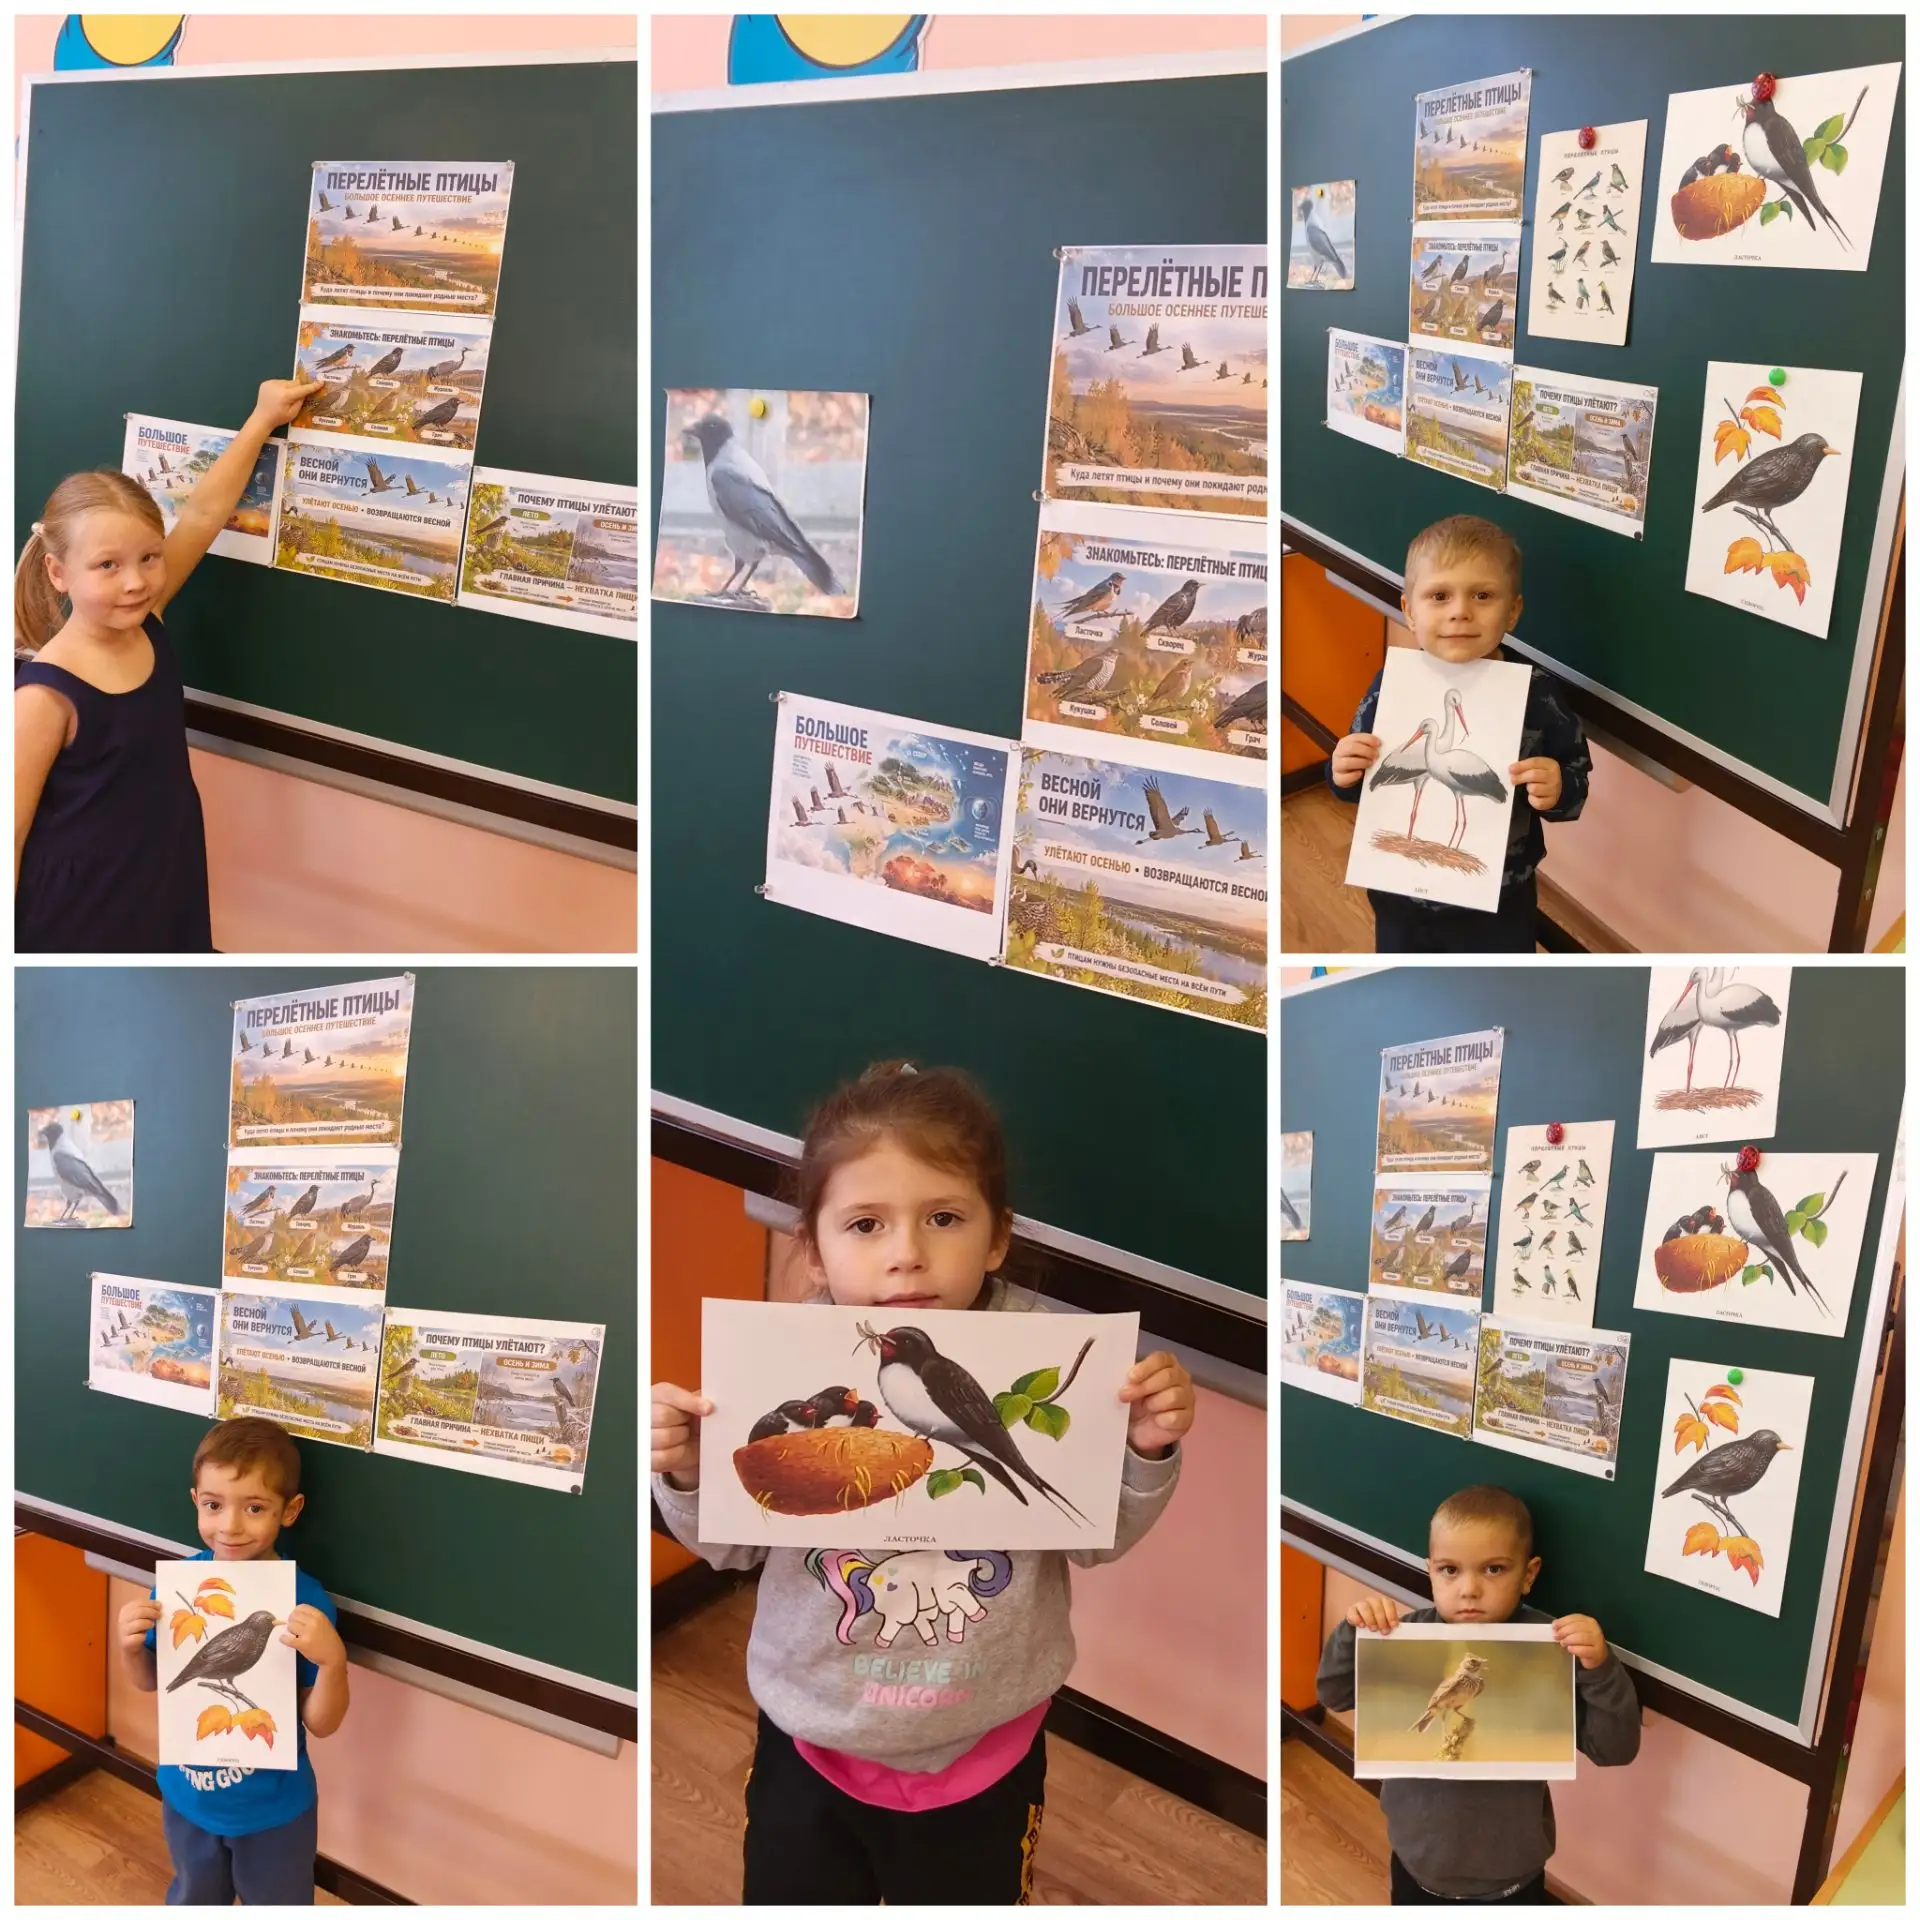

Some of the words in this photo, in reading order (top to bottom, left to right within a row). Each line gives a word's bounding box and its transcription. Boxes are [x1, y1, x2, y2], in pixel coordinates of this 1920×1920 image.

[1424, 90, 1482, 118] ПЕРЕЛЁТНЫЕ
[1484, 82, 1522, 107] ПТИЦЫ
[327, 168, 431, 191] ПЕРЕЛЁТНЫЕ
[436, 173, 498, 195] ПТИЦЫ
[344, 192, 378, 201] БОЛЬШОЕ
[381, 194, 414, 202] ОСЕННЕЕ
[417, 194, 472, 204] ПУТЕШЕСТВИЕ
[1082, 258, 1244, 298] ПЕРЕЛЁТНЫЕ
[1108, 303, 1162, 316] БОЛЬШОЕ
[1165, 304, 1218, 318] ОСЕННЕЕ
[330, 329, 381, 342] ЗНАКОМЬТЕСЬ:
[382, 333, 427, 345] ПЕРЕЛЁТНЫЕ
[428, 338, 454, 348] ПТИЦЫ
[1416, 359, 1438, 371] ВЕСНОЙ
[1416, 372, 1426, 382] ОНИ
[1426, 374, 1454, 386] ВЕРНУТСЯ
[1540, 390, 1562, 402] ПОЧЕМУ
[1563, 394, 1583, 406] ПТИЦЫ
[1584, 397, 1618, 411] УЛЁТАЮТ?
[138, 426, 188, 444] БОЛЬШОЕ
[138, 438, 190, 454] ПУТЕШЕСТВИЕ
[300, 456, 339, 472] ВЕСНОЙ
[299, 470, 318, 481] ОНИ
[320, 472, 368, 488] ВЕРНУТСЯ
[1070, 468, 1090, 482] Куда
[1091, 472, 1114, 482] летят
[1116, 474, 1142, 486] птицы
[1152, 477, 1182, 490] почему
[1185, 479, 1200, 488] они
[1202, 479, 1244, 492] покидают
[302, 496, 330, 509] УЛЁТАЮТ
[332, 502, 359, 512] ОСЕНЬЮ
[366, 508, 422, 523] ВОЗВРАЩАЮТСЯ
[424, 516, 451, 528] ВЕСНОЙ
[518, 494, 555, 508] ПОЧЕМУ
[556, 498, 590, 512] ПТИЦЫ
[593, 503, 638, 518] УЛЁТАЮТ
[522, 511, 539, 519] ЛЕТО
[600, 521, 620, 530] ОСЕНЬ
[1086, 545, 1165, 568] ЗНАКОМЬТЕСЬ:
[1166, 553, 1236, 576] ПЕРЕЛЁТНЫЕ
[1238, 563, 1268, 582] ПТИЦ
[500, 572, 530, 584] ГЛАВНАЯ
[532, 577, 565, 590] ПРИЧИНА
[574, 586, 614, 598] НЕХВАТКА
[1074, 627, 1104, 638] Ласточка
[1158, 638, 1185, 650] Скворец
[1069, 704, 1096, 716] Кукушка
[796, 715, 868, 748] БОЛЬШОЕ
[1150, 717, 1178, 730] Соловей
[1245, 733, 1261, 744] Грач
[794, 736, 872, 766] ПУТЕШЕСТВИЕ
[1041, 773, 1100, 800] ВЕСНОЙ
[1038, 796, 1068, 816] ОНИ
[1072, 802, 1146, 832] ВЕРНУТСЯ
[1044, 845, 1088, 864] УЛЁТАЮТ
[1091, 856, 1131, 873] ОСЕНЬЮ
[1144, 866, 1228, 894] ВОЗВРАЩАЮТСЯ
[1068, 952, 1092, 964] ПТИЦАМ
[1094, 958, 1116, 971] НУЖНЫ
[1118, 963, 1158, 981] БЕЗОПАСНЫЕ
[1160, 973, 1180, 985] МЕСТА
[1181, 978, 1190, 988] НА
[1192, 980, 1208, 992] ВСЁМ
[1210, 986, 1226, 997] ПУТИ
[246, 998, 339, 1028] ПЕРЕЛЁТНЫЕ
[342, 990, 400, 1017] ПТИЦЫ
[294, 1024, 324, 1034] ОСЕННЕЕ
[326, 1016, 376, 1031] ПУТЕШЕСТВИЕ
[1390, 1047, 1452, 1072] ПЕРЕЛЁТНЫЕ
[1454, 1040, 1494, 1062] ПТИЦЫ
[254, 1172, 298, 1180] ЗНАКОМЬТЕСЬ:
[300, 1170, 340, 1181] ПЕРЕЛЁТНЫЕ
[341, 1172, 364, 1182] ПТИЦЫ
[102, 1284, 140, 1300] БОЛЬШОЕ
[101, 1296, 142, 1308] ПУТЕШЕСТВИЕ
[234, 1306, 266, 1320] ВЕСНОЙ
[1376, 1309, 1400, 1320] ВЕСНОЙ
[232, 1319, 249, 1330] ОНИ
[251, 1322, 292, 1336] ВЕРНУТСЯ
[1375, 1320, 1386, 1330] ОНИ
[1387, 1323, 1416, 1336] ВЕРНУТСЯ
[426, 1334, 460, 1346] ПОЧЕМУ
[462, 1338, 493, 1350] ПТИЦЫ
[495, 1340, 546, 1354] УЛЁТАЮТ?
[1510, 1337, 1532, 1348] ПОЧЕМУ
[1534, 1340, 1554, 1352] ПТИЦЫ
[1556, 1342, 1590, 1358] УЛЁТАЮТ?
[292, 1356, 341, 1370] ВОЗВРАЩАЮТСЯ
[342, 1362, 366, 1373] ВЕСНОЙ
[430, 1352, 446, 1360] ЛЕТО
[504, 1358, 523, 1367] ОСЕНЬ
[531, 1361, 550, 1370] ЗИМА
[410, 1417, 440, 1430] ГЛАВНАЯ
[441, 1422, 472, 1434] ПРИЧИНА
[480, 1428, 518, 1441] НЕХВАТКА
[520, 1434, 544, 1445] ПИЩИ
[853, 1654, 952, 1684] BELIEVE
